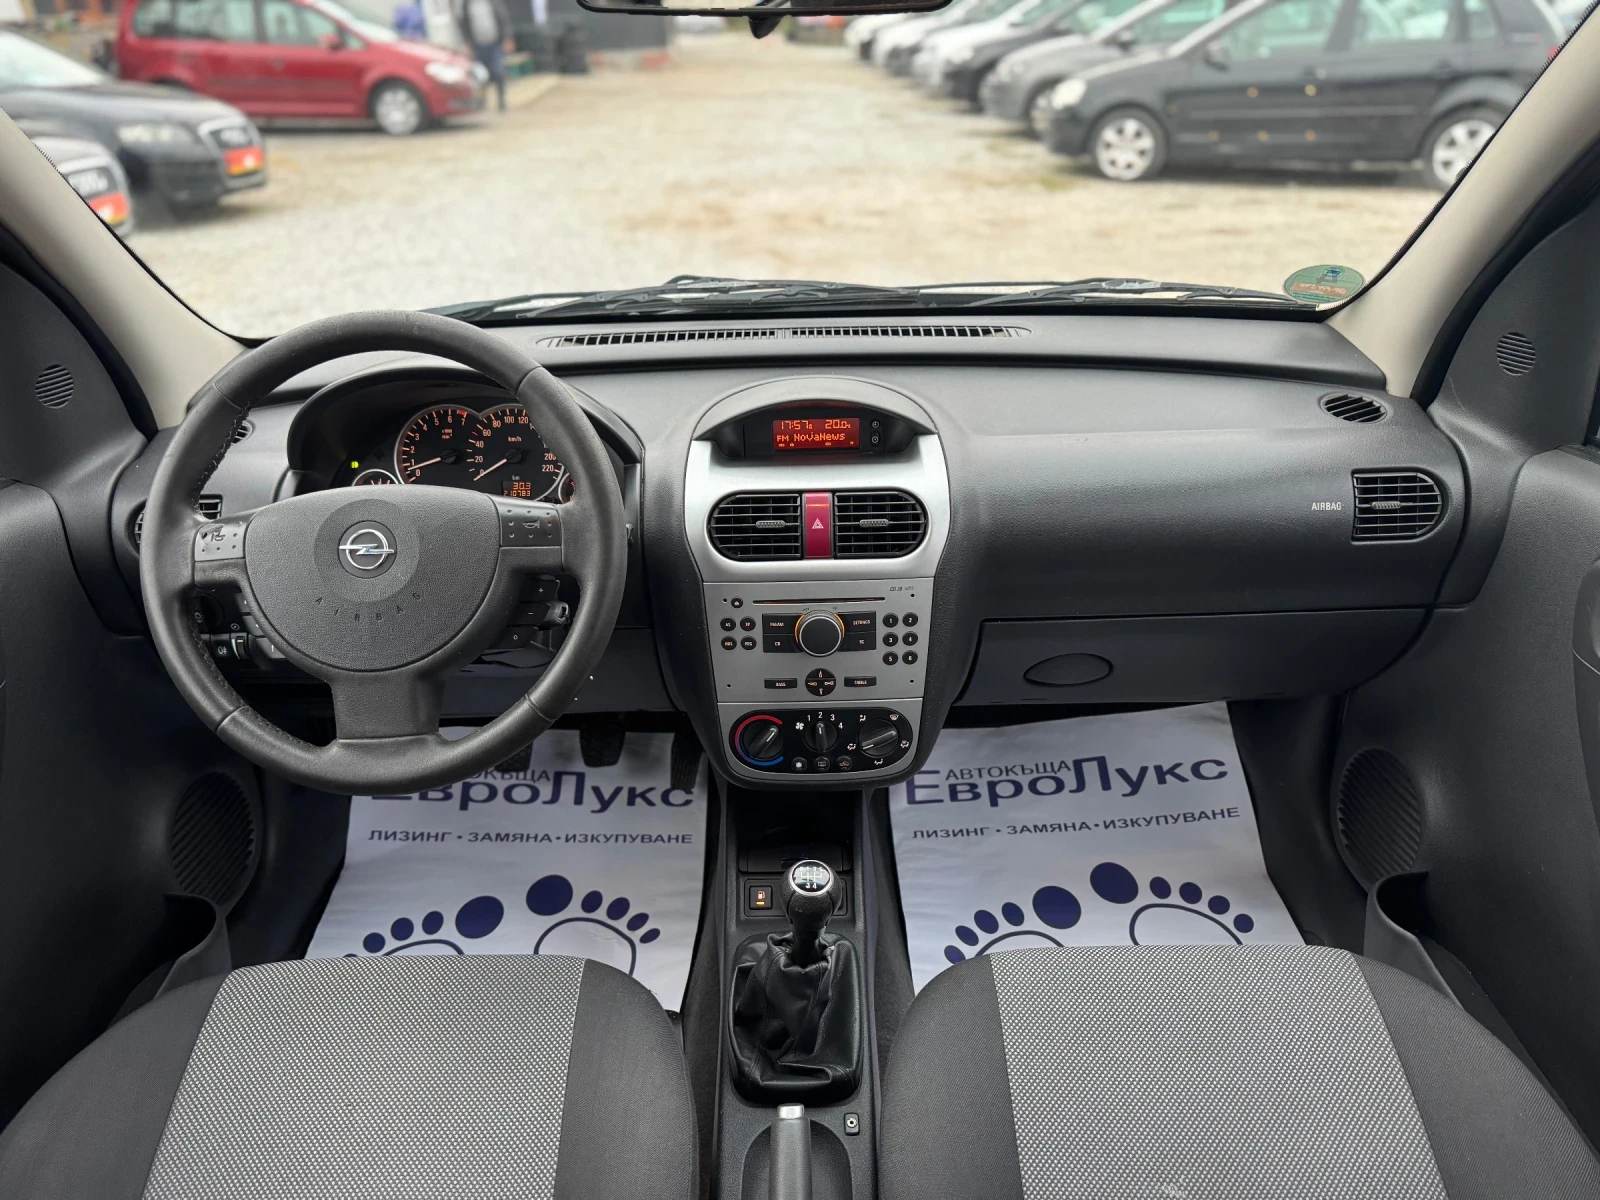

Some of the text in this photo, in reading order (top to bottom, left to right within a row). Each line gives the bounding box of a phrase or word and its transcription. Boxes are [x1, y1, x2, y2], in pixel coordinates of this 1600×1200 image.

[434, 418, 439, 426] 5
[447, 415, 453, 423] 6
[461, 418, 466, 426] 7
[504, 416, 514, 424] 100
[518, 416, 529, 424] 120
[422, 424, 428, 432] 4
[492, 420, 501, 428] 80
[414, 433, 420, 441] 3
[482, 429, 492, 437] 60
[776, 431, 846, 442] FM NovaNews
[475, 440, 484, 448] 40
[410, 446, 415, 454] 2
[474, 455, 484, 463] 20
[541, 464, 554, 472] 220
[415, 469, 421, 477] 0
[1311, 501, 1342, 511] AIRBAG
[314, 591, 421, 622] AIRBAG
[818, 711, 823, 719] 2
[945, 760, 1071, 781] АВТОКЪЩА
[905, 755, 1229, 807] ЕвроЛукс
[371, 771, 694, 813] вроЛукс
[912, 806, 1241, 839] ЛИЗИНГ ЗАМЯНА ИЗКУПУВАНЕ
[368, 829, 693, 844] ЛИЗИНГ ЗАМЯНА ИЗКУПУВАНЕ
